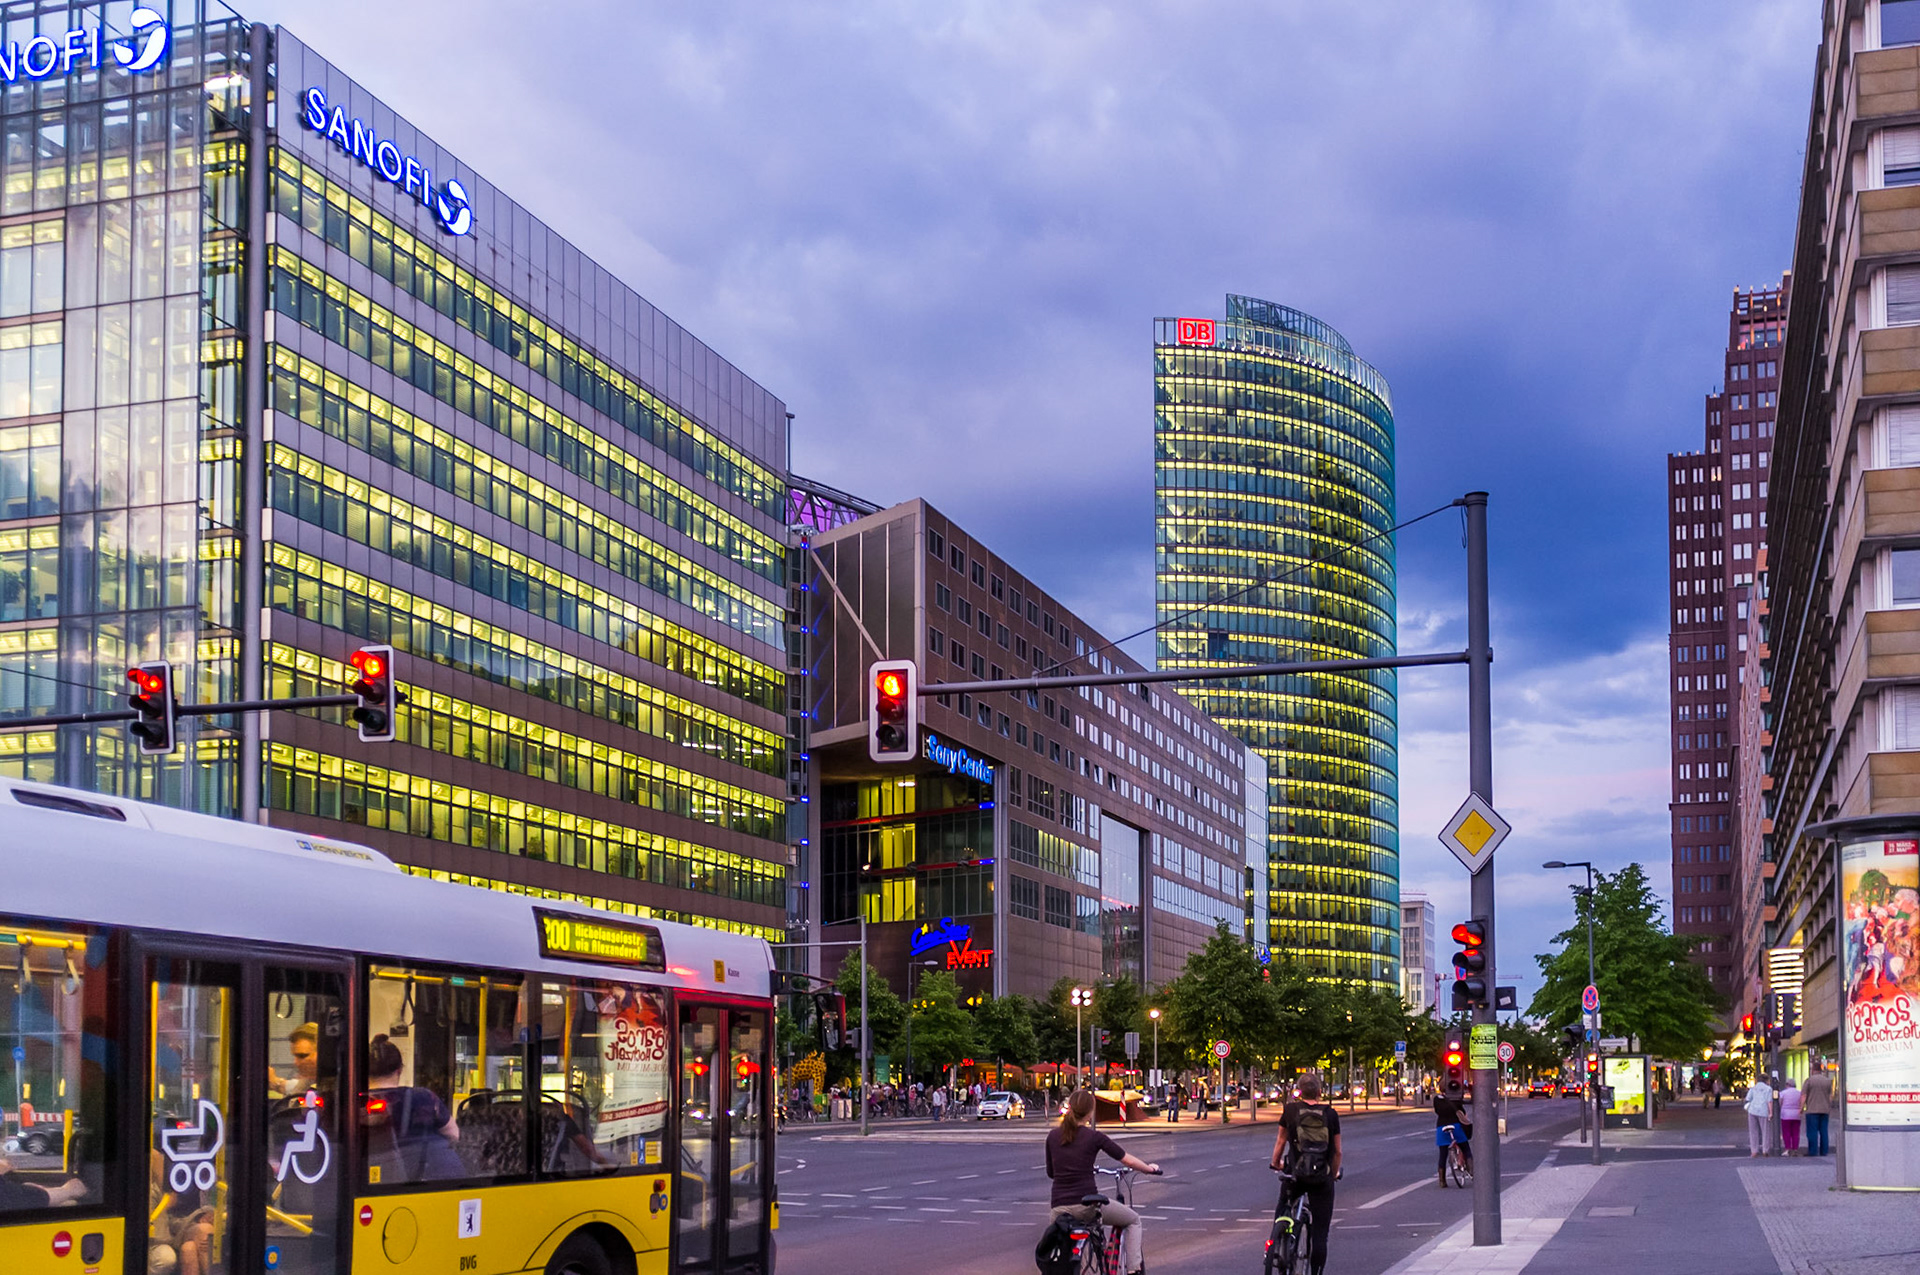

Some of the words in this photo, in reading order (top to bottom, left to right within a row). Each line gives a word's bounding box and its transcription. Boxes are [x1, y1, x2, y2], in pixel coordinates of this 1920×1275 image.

[305, 86, 431, 206] SANOFI
[1182, 322, 1211, 341] DB
[927, 734, 957, 774] Sony
[958, 748, 994, 784] Center
[311, 843, 374, 861] KONVEKTA
[574, 923, 643, 947] Michelangelostr.
[575, 938, 590, 952] via
[591, 939, 643, 959] Alexanderpl.
[946, 938, 994, 966] EVENT
[1866, 1020, 1920, 1042] Hochzeit
[1217, 1045, 1227, 1053] 30
[1500, 1048, 1511, 1058] 30
[460, 1254, 477, 1271] BVG
